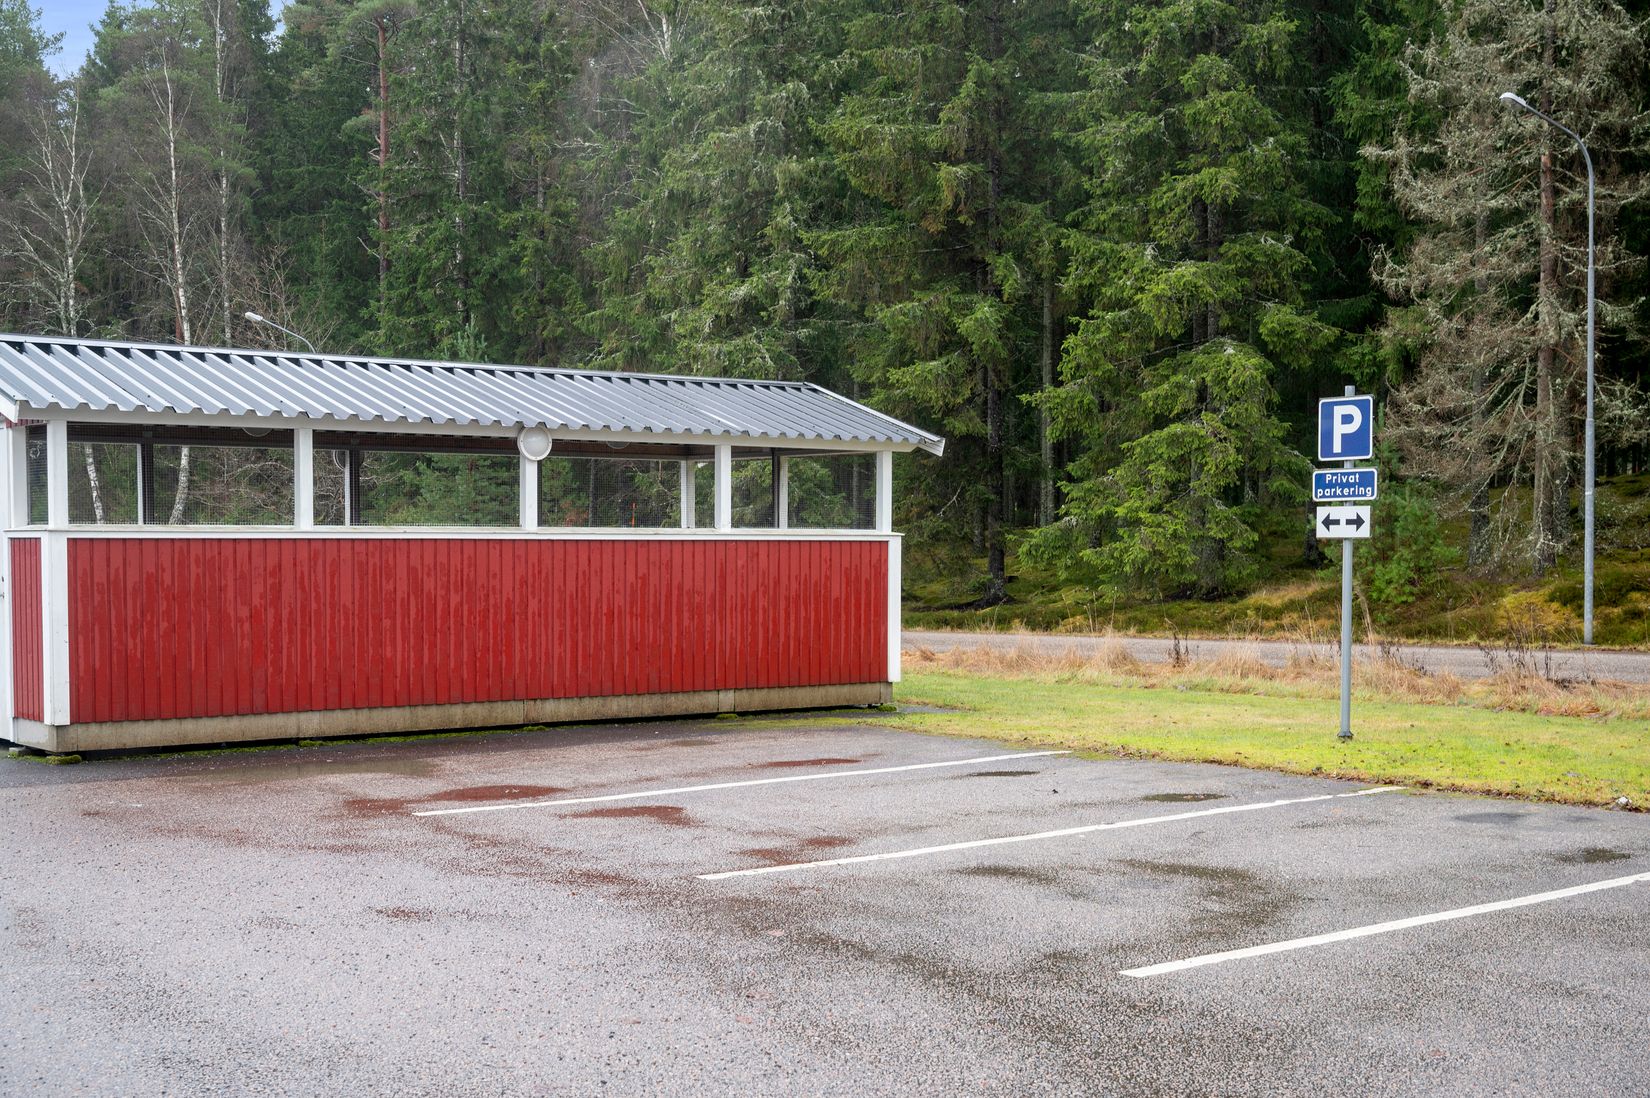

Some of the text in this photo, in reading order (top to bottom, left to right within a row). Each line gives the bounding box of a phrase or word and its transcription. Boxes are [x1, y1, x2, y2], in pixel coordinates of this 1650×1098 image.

[1332, 404, 1362, 454] P
[1325, 473, 1360, 484] Privat
[1317, 485, 1372, 498] parkering
